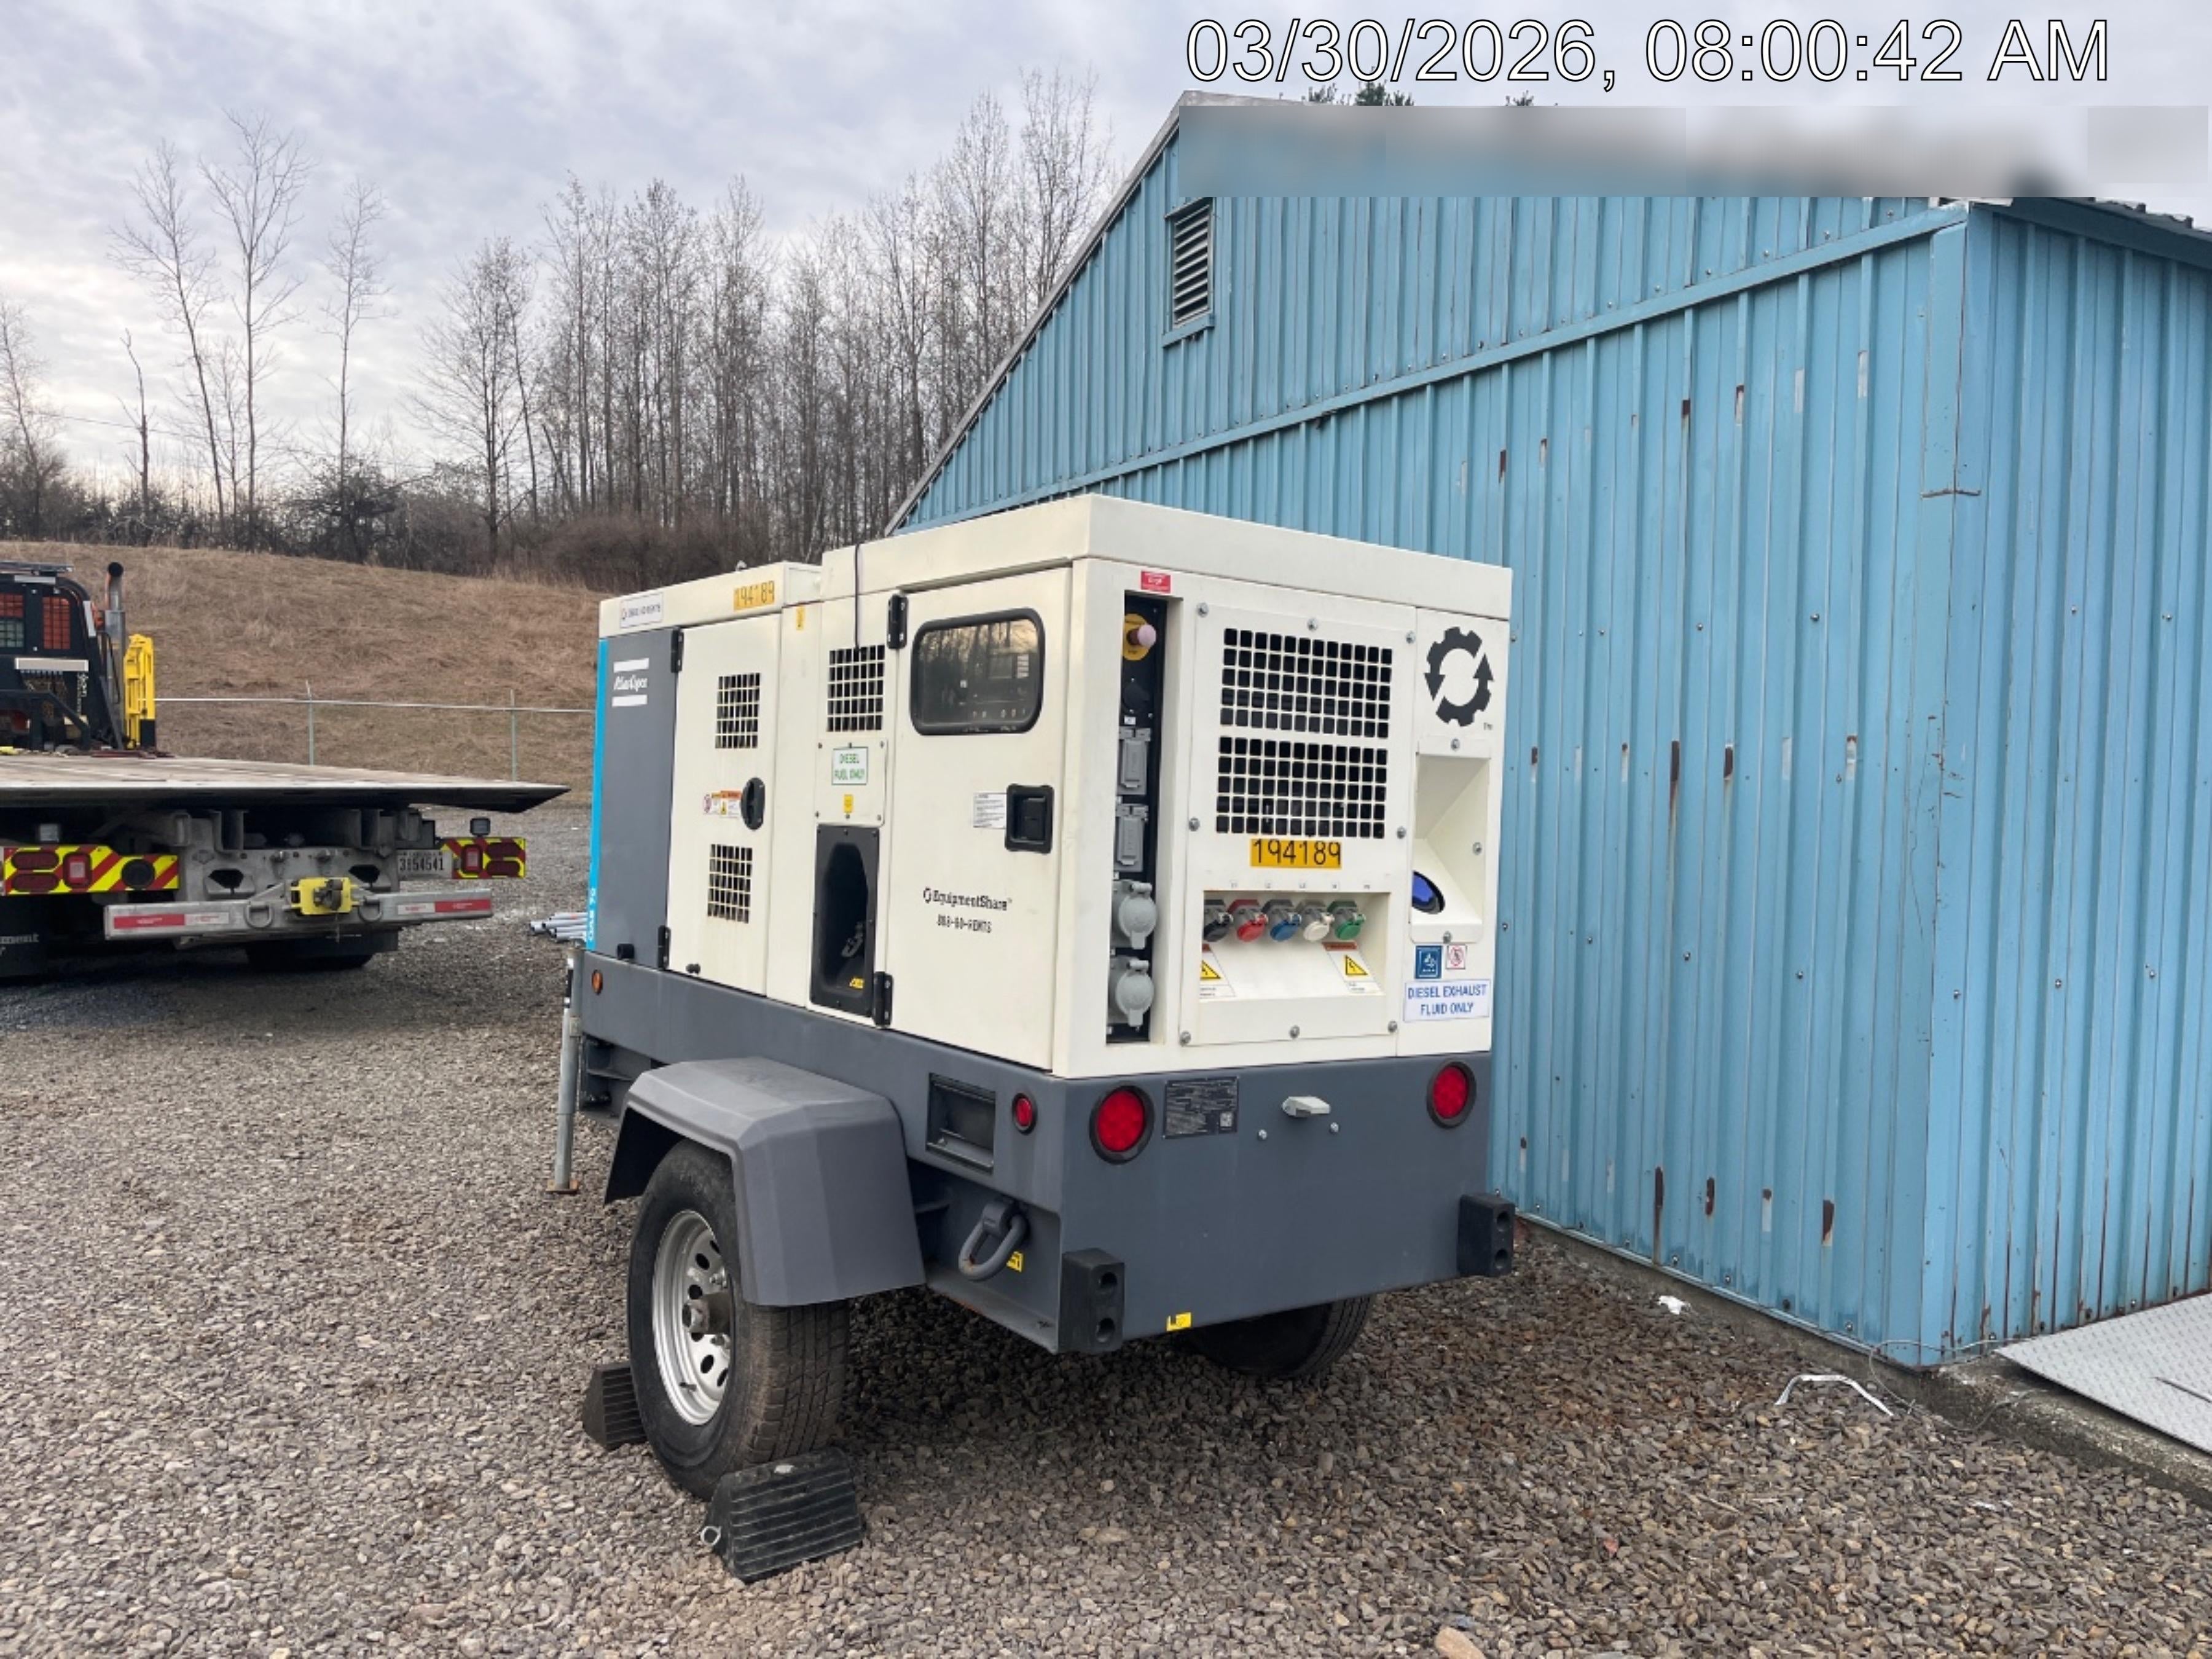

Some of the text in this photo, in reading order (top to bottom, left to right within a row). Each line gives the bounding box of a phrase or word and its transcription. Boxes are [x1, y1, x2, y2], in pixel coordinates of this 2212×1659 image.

[735, 581, 774, 608] 194189
[840, 753, 860, 764] DIESEL
[834, 768, 865, 780] FUEL ONLY
[1253, 839, 1341, 866] 194189
[933, 890, 1007, 911] EquipmentShare
[1408, 984, 1488, 1000] DIESEL EXHAUST
[1421, 1002, 1474, 1016] FLUID ONLY
